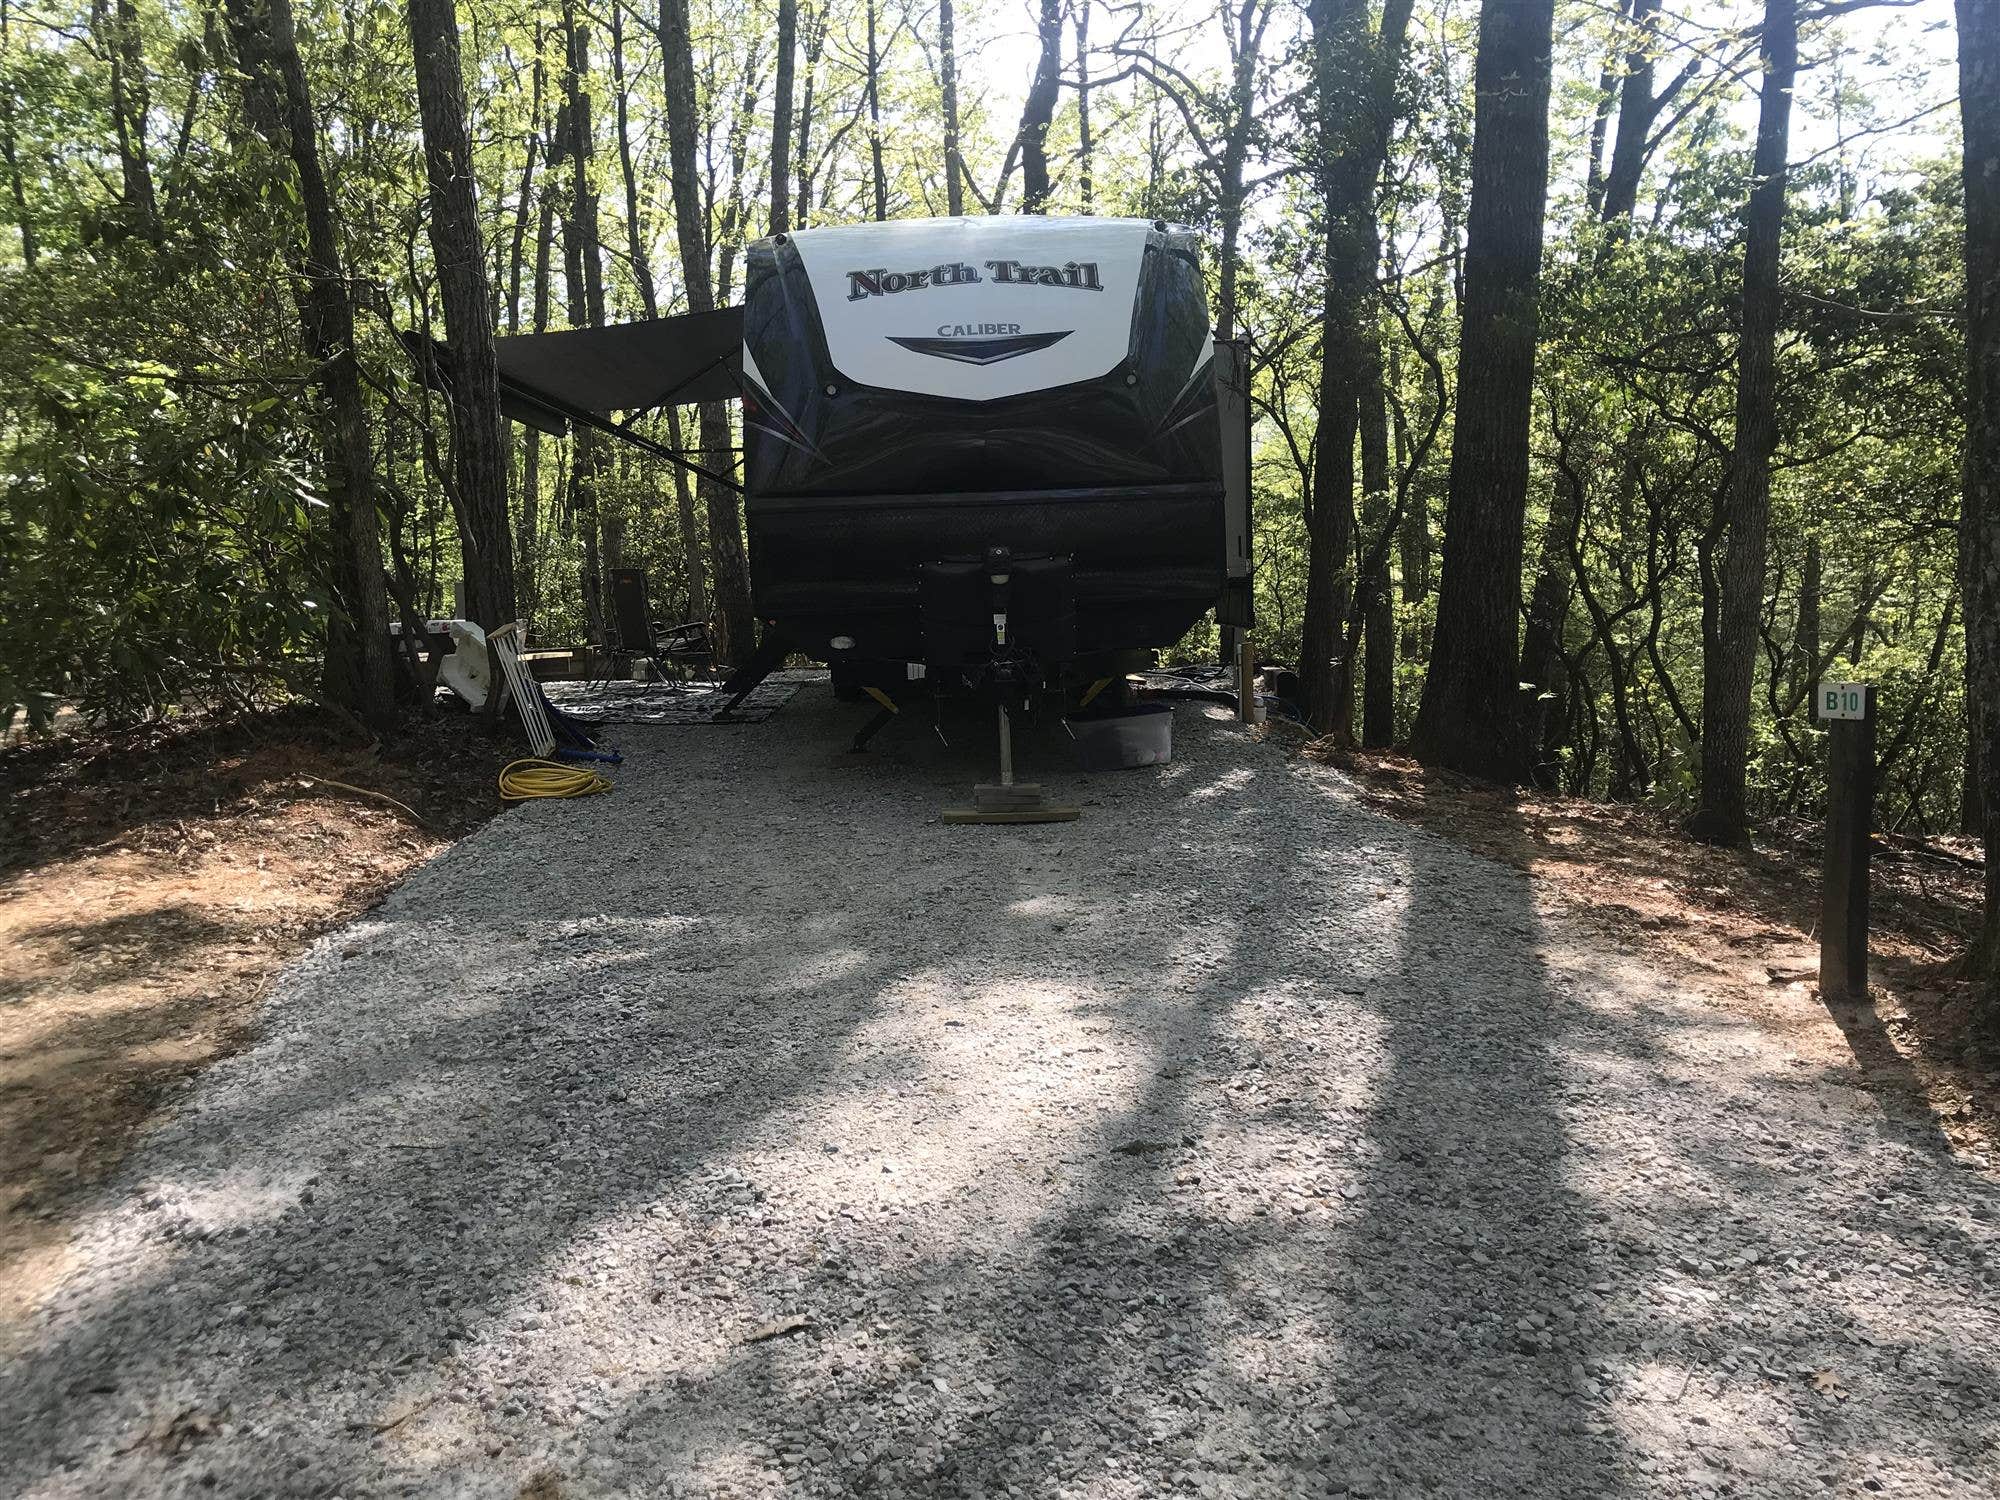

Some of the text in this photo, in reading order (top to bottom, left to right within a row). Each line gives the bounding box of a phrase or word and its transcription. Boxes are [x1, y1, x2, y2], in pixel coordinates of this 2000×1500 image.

[846, 260, 1104, 301] North Trail
[937, 323, 1021, 336] CALIBER
[1826, 691, 1859, 711] B10
